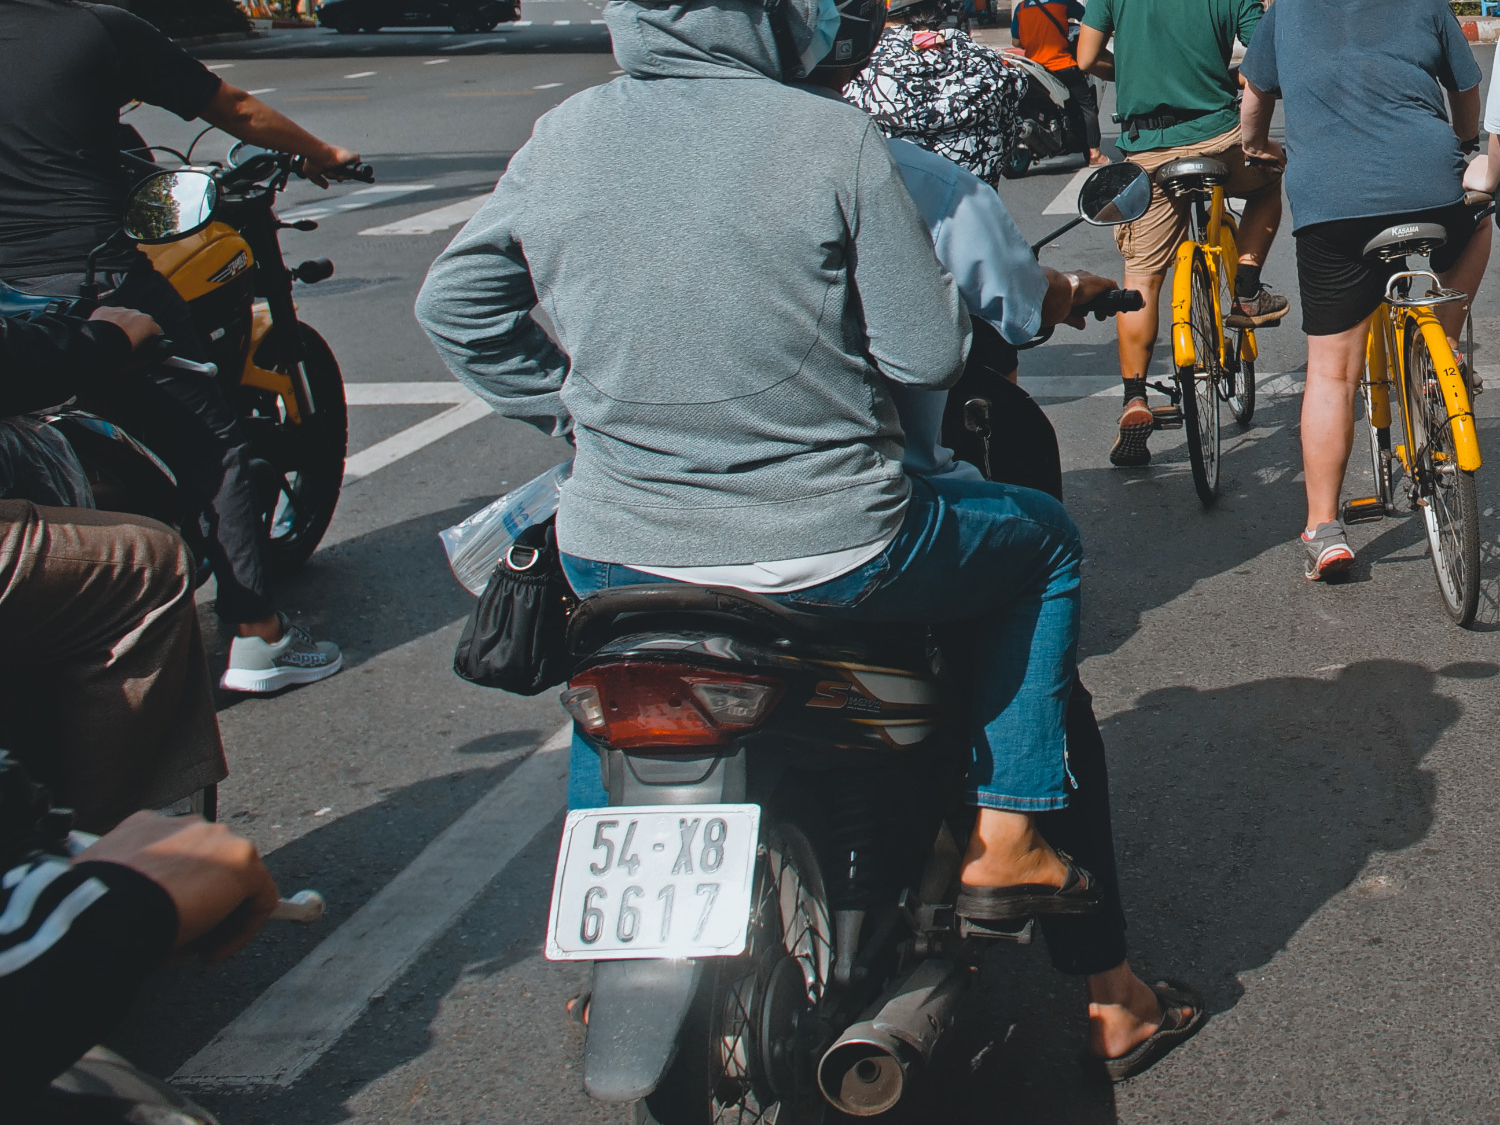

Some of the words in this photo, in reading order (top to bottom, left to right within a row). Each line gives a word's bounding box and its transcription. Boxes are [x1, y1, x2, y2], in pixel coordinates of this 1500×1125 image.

[1443, 367, 1458, 377] 12
[589, 817, 729, 877] 54-X8
[579, 882, 721, 945] 6617
